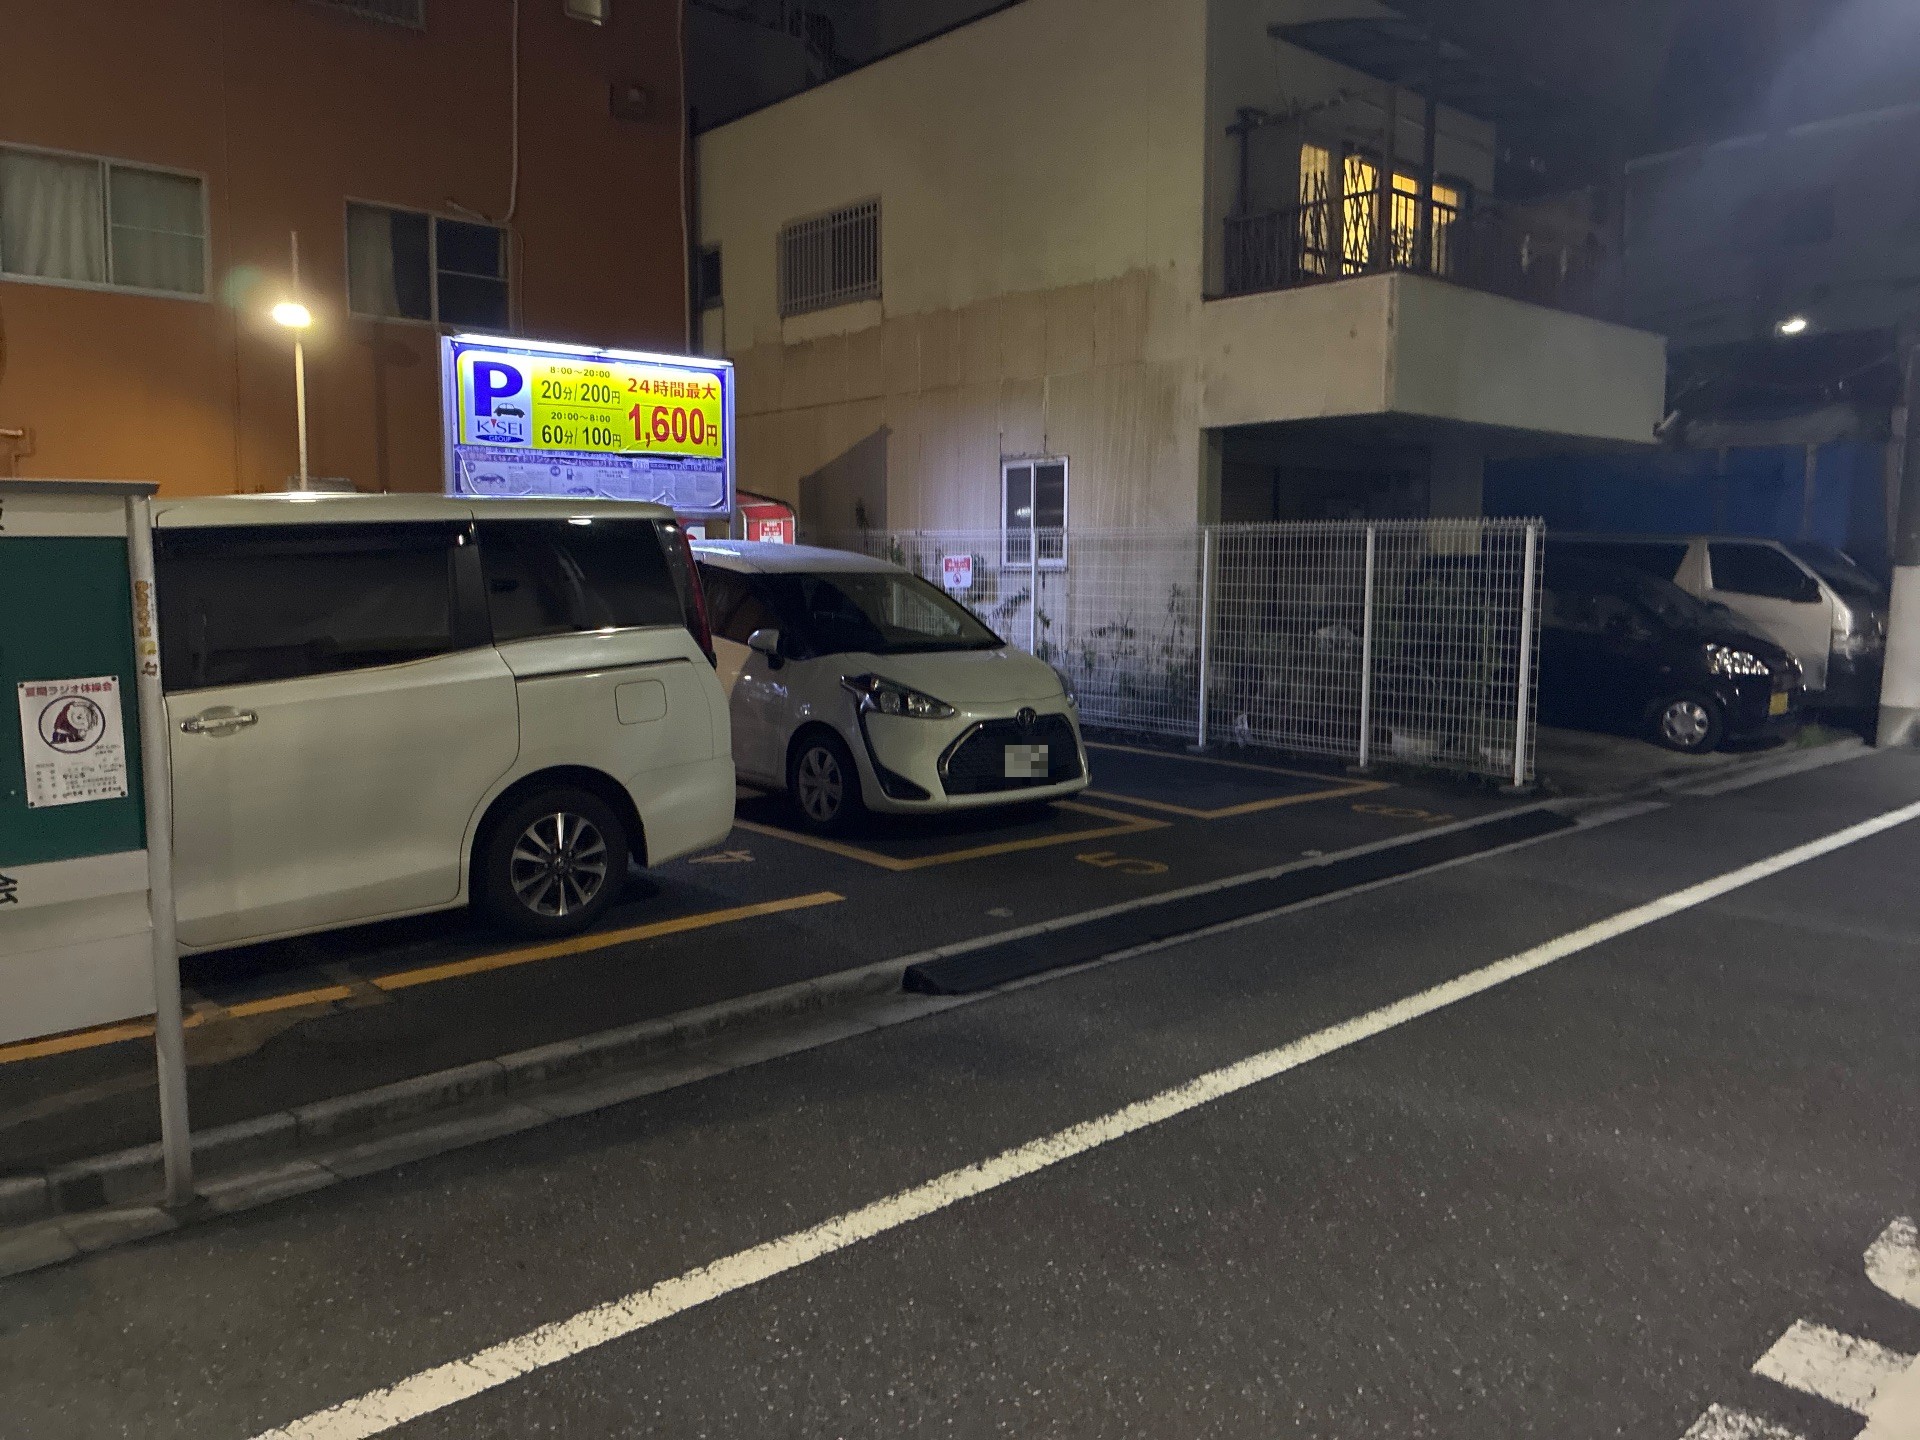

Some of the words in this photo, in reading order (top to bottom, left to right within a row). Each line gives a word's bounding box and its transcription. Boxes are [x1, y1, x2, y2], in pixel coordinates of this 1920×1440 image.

[473, 361, 523, 417] P
[541, 380, 620, 404] 20分/200円
[627, 377, 717, 400] 24時間最大
[541, 424, 622, 448] 60分/100円
[628, 403, 718, 448] 1,600円
[488, 434, 512, 442] GROUP
